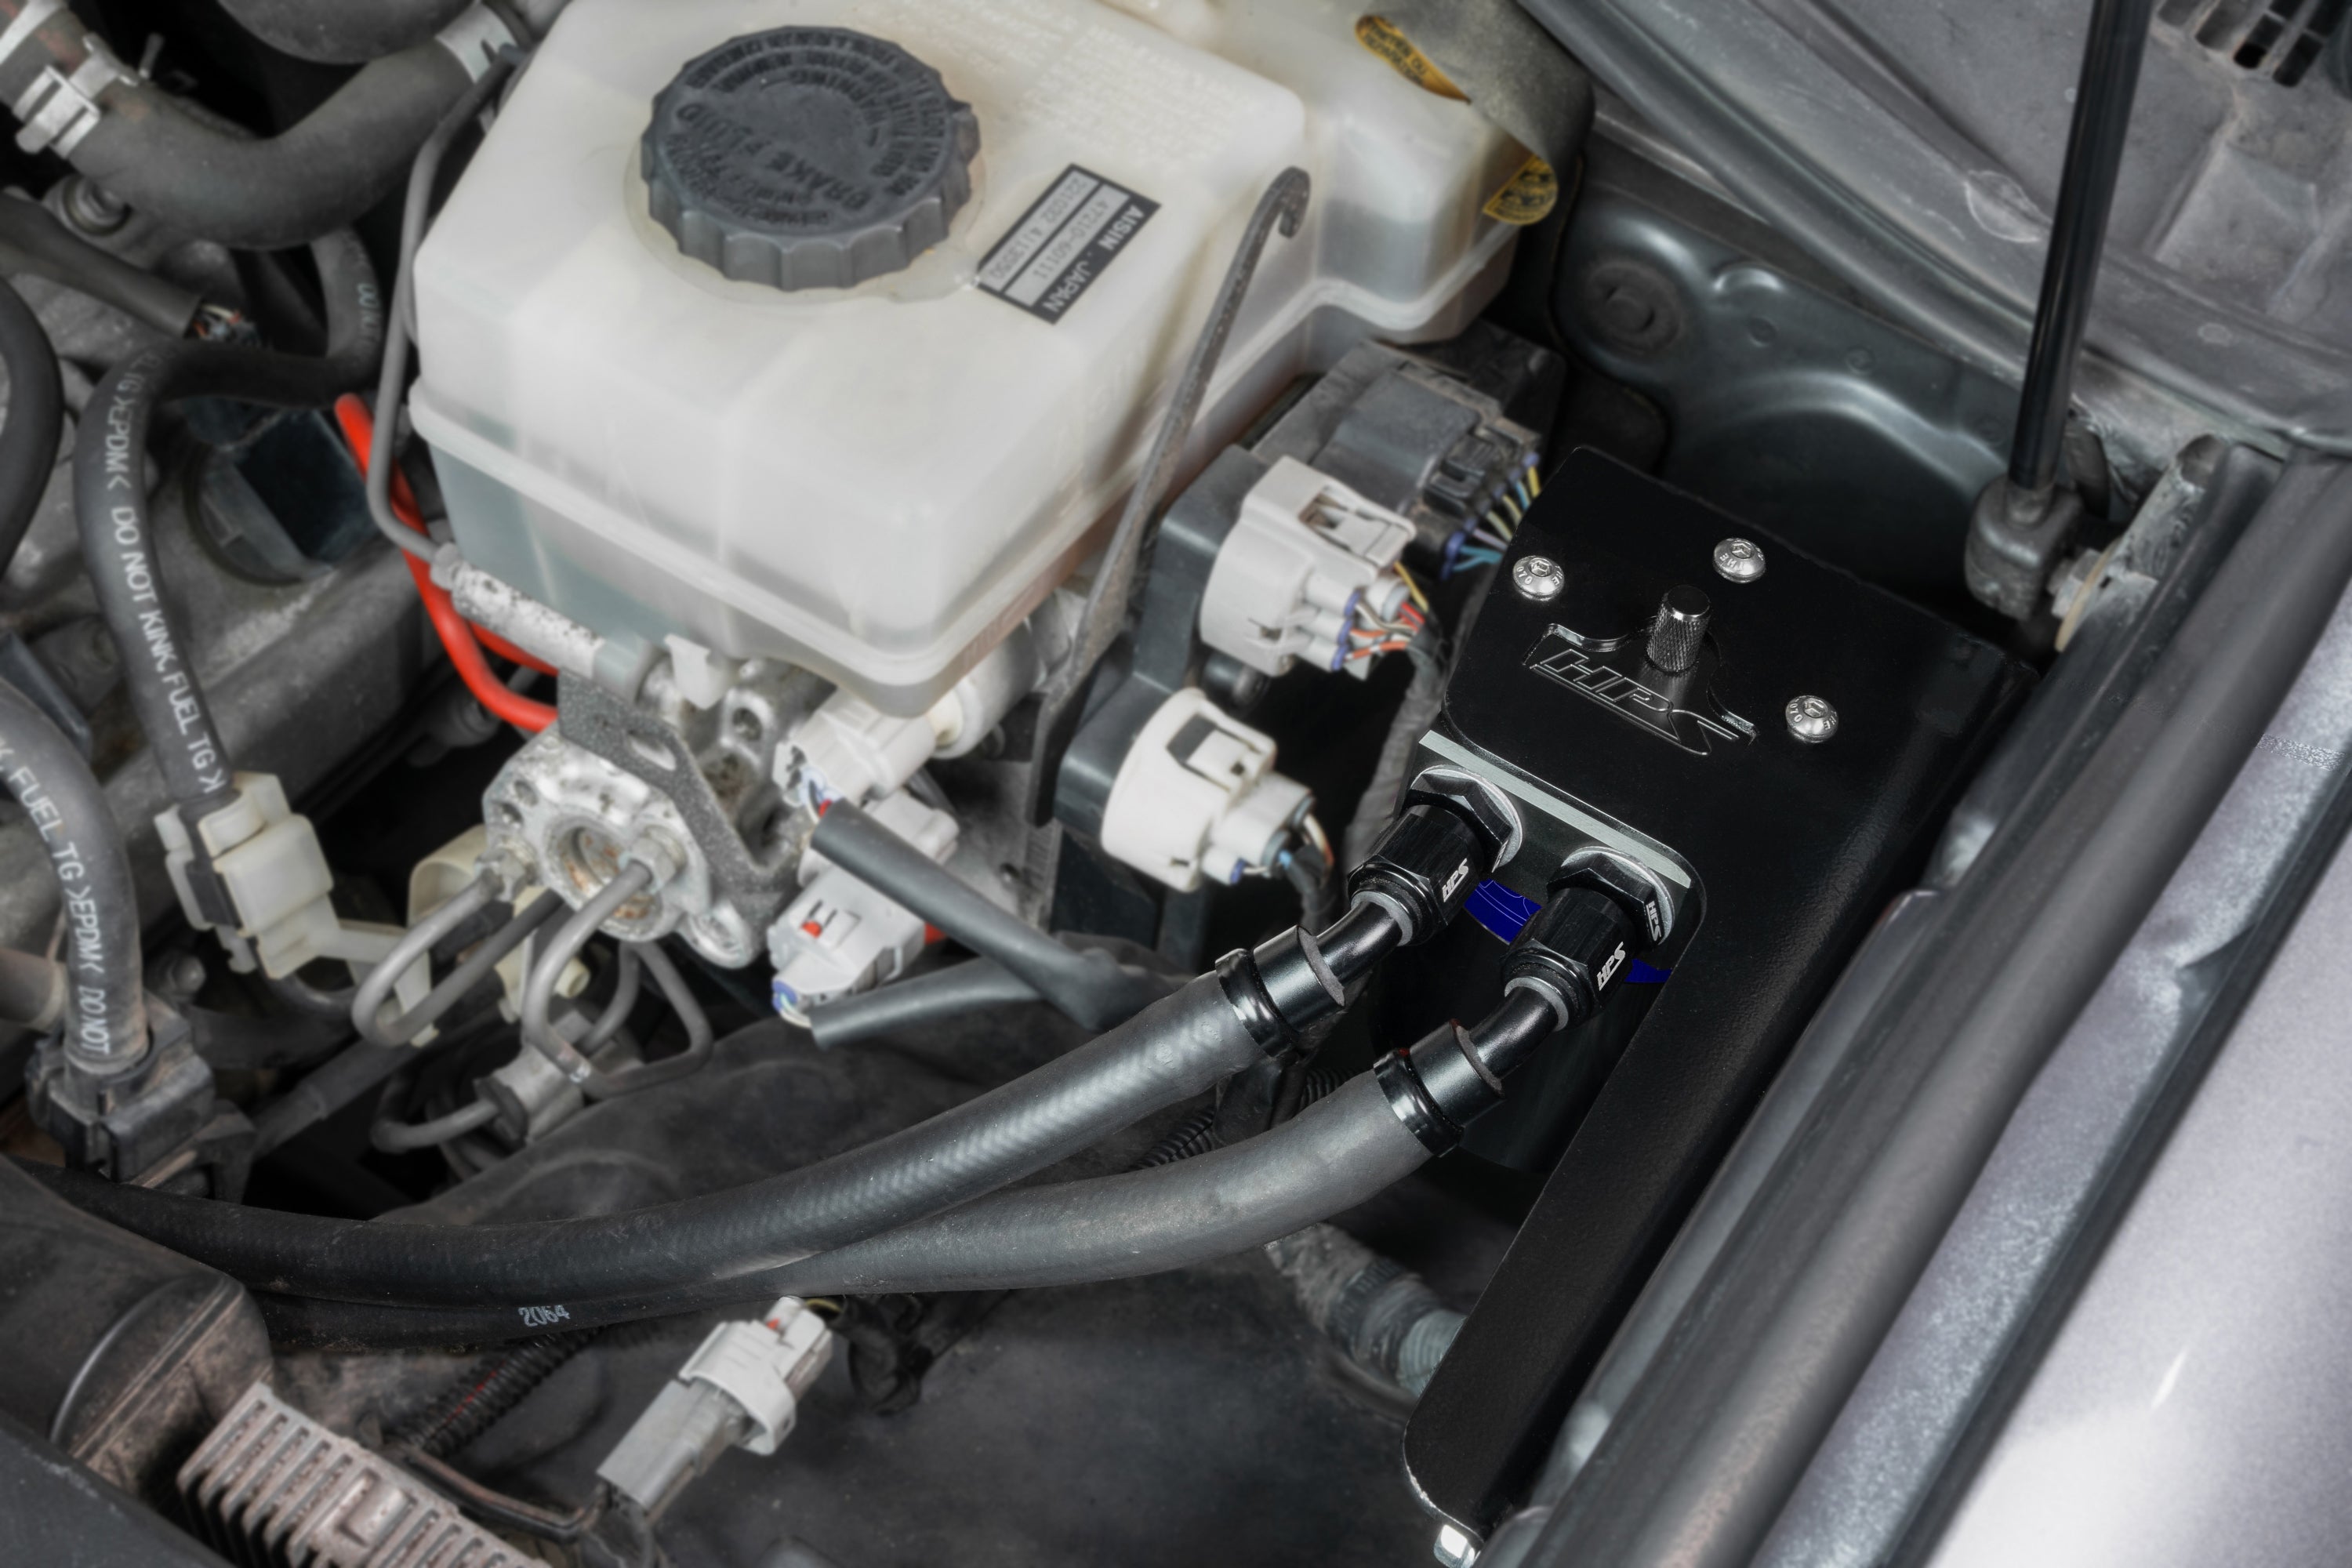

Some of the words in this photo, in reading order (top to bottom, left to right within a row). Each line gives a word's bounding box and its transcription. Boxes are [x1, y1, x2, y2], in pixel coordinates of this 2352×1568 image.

[676, 103, 771, 157] FLUID
[767, 153, 871, 212] BRAKE
[1099, 203, 1144, 250] AISIN
[1043, 261, 1091, 312] JAPAN
[111, 506, 140, 545] DO
[121, 551, 158, 602] NOT
[162, 671, 201, 736] FUEL
[1530, 648, 1739, 756] HPS
[187, 731, 216, 770] TG
[8, 765, 63, 843] FUEL
[52, 841, 85, 881] TG
[1442, 858, 1469, 903] HPS
[64, 885, 105, 973] >EPDM<
[1646, 900, 1662, 942] HPS
[1596, 941, 1626, 992] HPS
[78, 985, 107, 1014] DO
[79, 1014, 111, 1054] NOT
[517, 1305, 571, 1327] 2064
